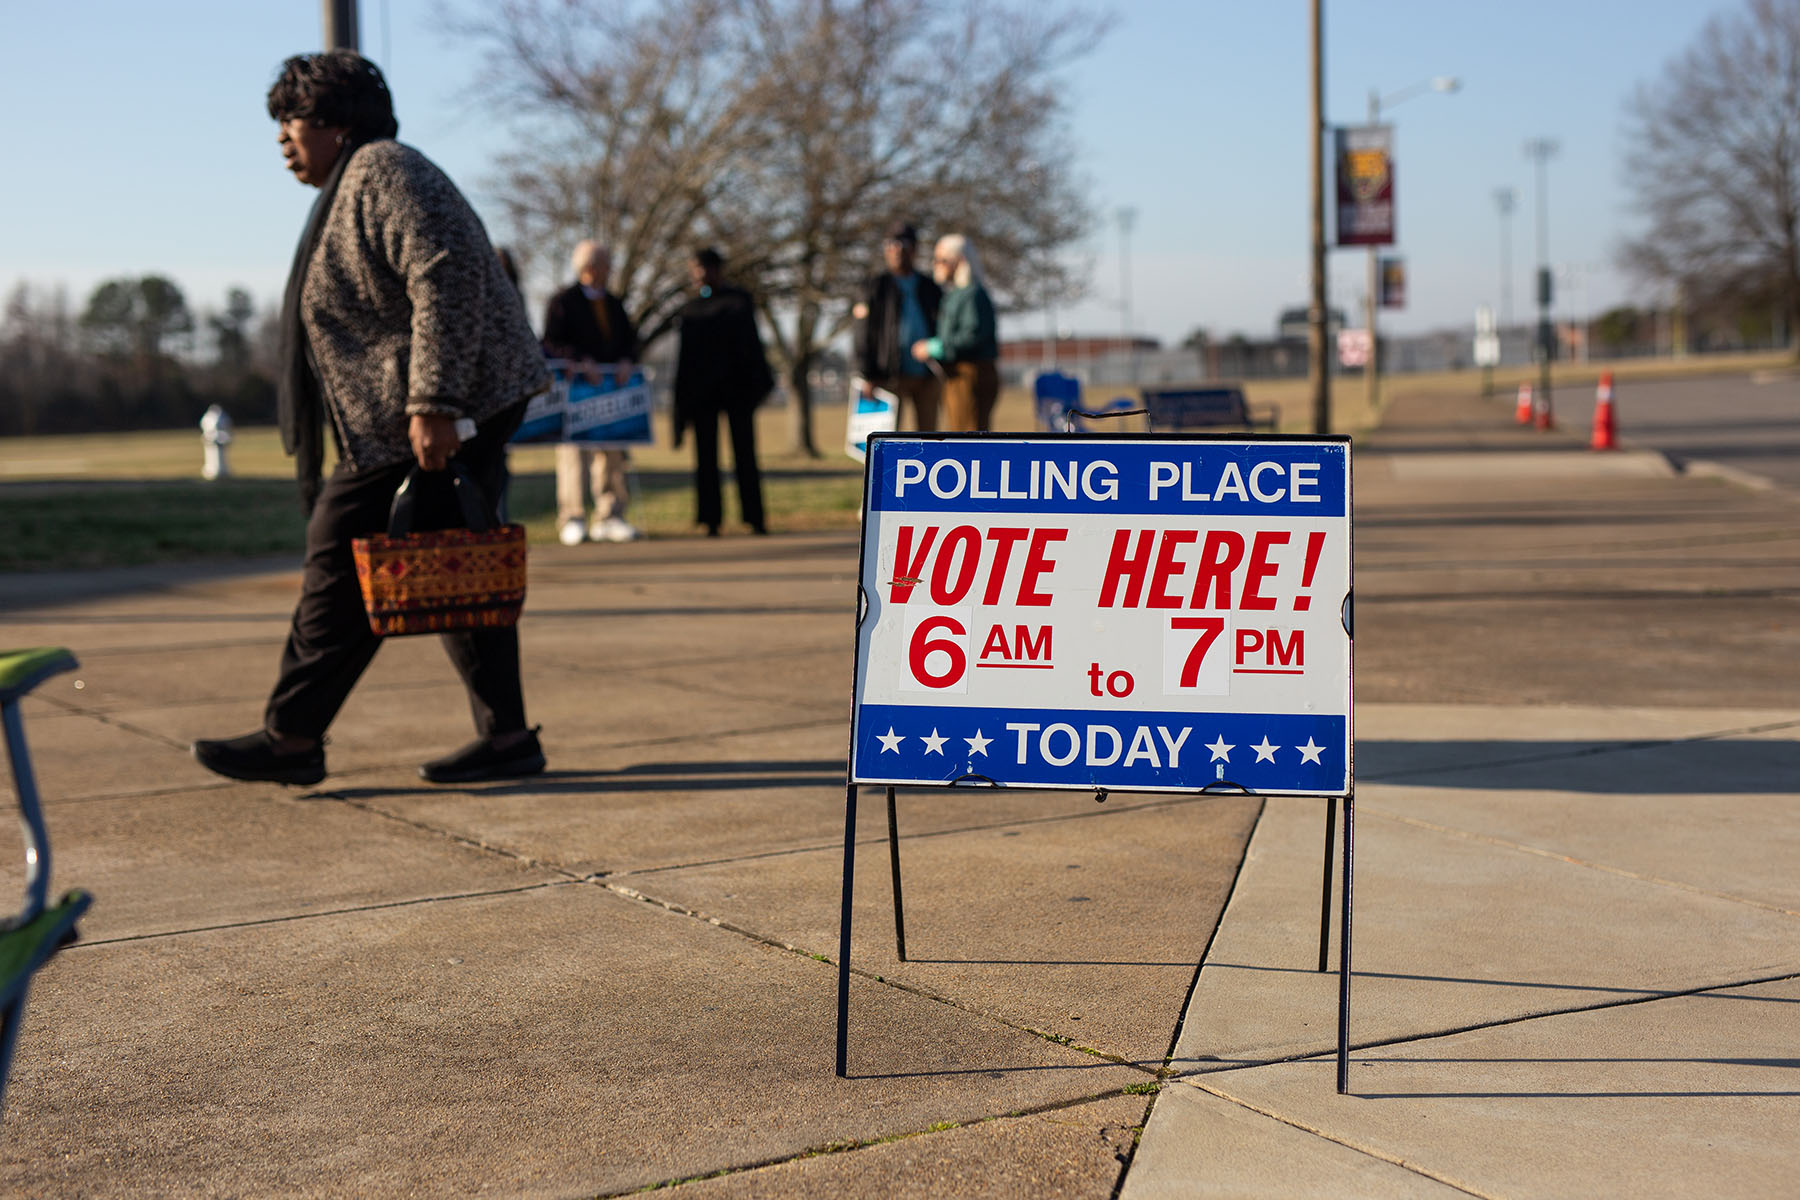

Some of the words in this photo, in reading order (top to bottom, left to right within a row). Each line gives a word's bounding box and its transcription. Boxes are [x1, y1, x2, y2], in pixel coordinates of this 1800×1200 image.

[895, 458, 1119, 502] POLLING
[1149, 461, 1321, 503] PLACE
[889, 525, 1069, 607] VOTE
[1097, 529, 1327, 611] HERE!
[908, 615, 967, 689] 6
[979, 623, 1054, 661] AM
[1087, 662, 1135, 698] to
[1170, 616, 1225, 688] 7
[1235, 628, 1305, 667] PM
[1005, 722, 1193, 768] TODAY
